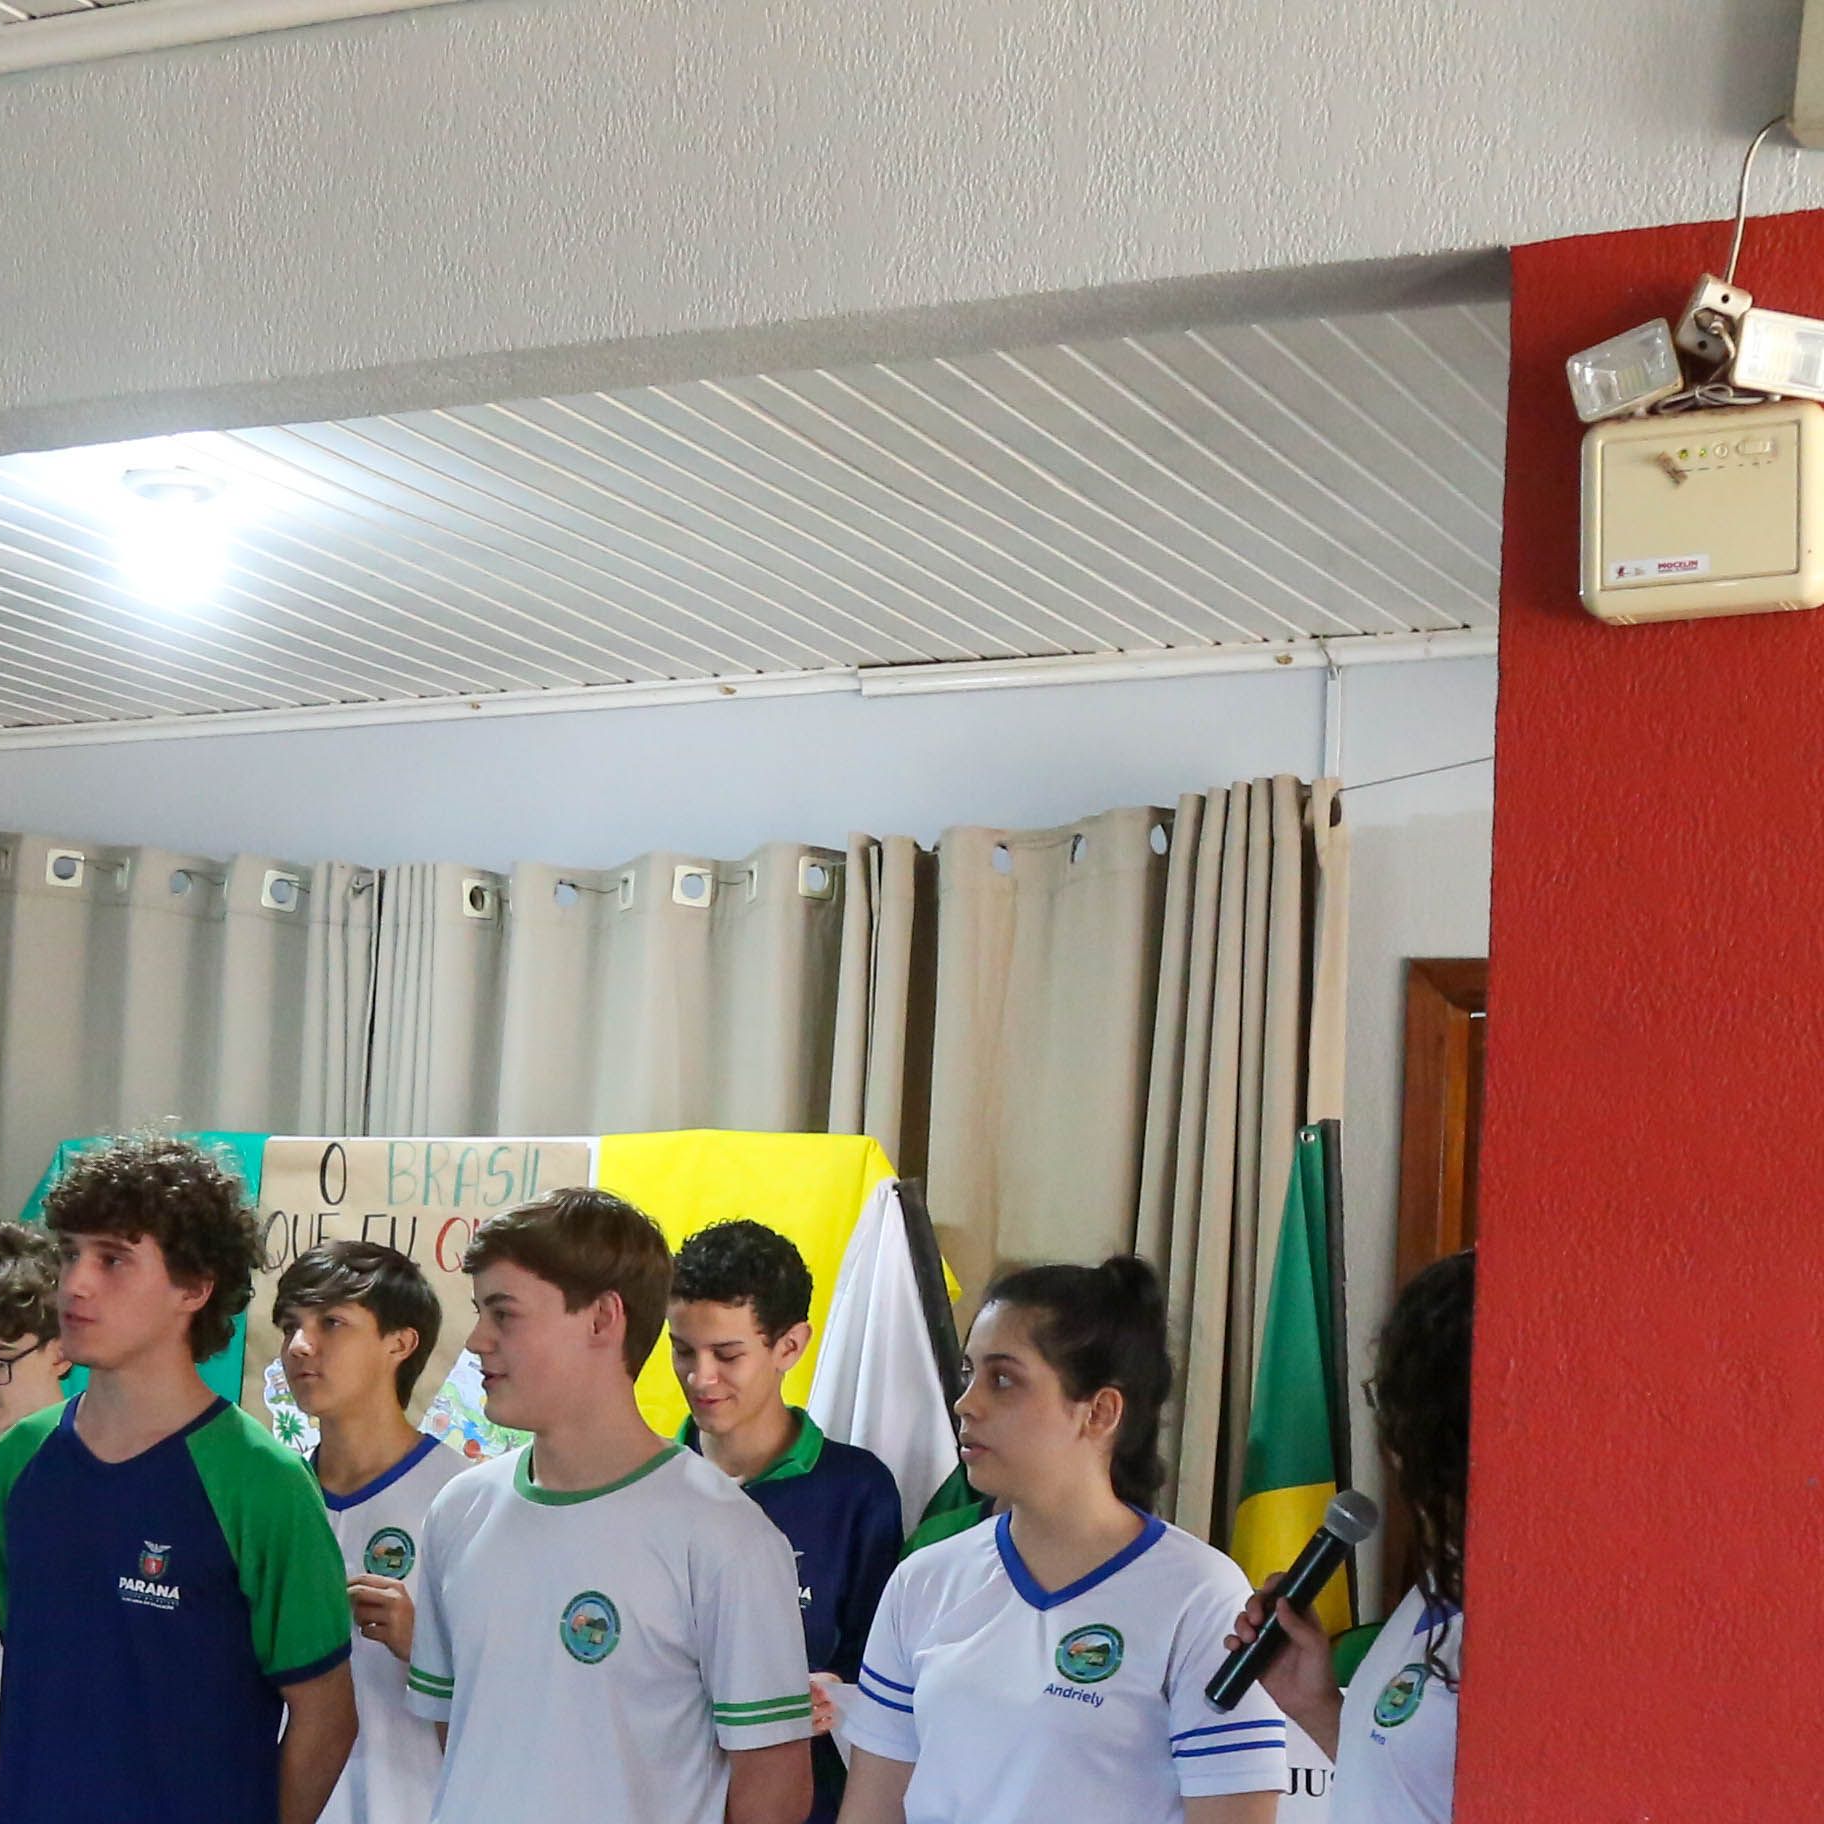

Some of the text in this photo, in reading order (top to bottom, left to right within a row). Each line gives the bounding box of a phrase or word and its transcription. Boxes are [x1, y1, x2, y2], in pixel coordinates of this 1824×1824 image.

[320, 1142, 347, 1206] O
[119, 1576, 180, 1600] PARANÁ
[1043, 1683, 1104, 1708] Andriely
